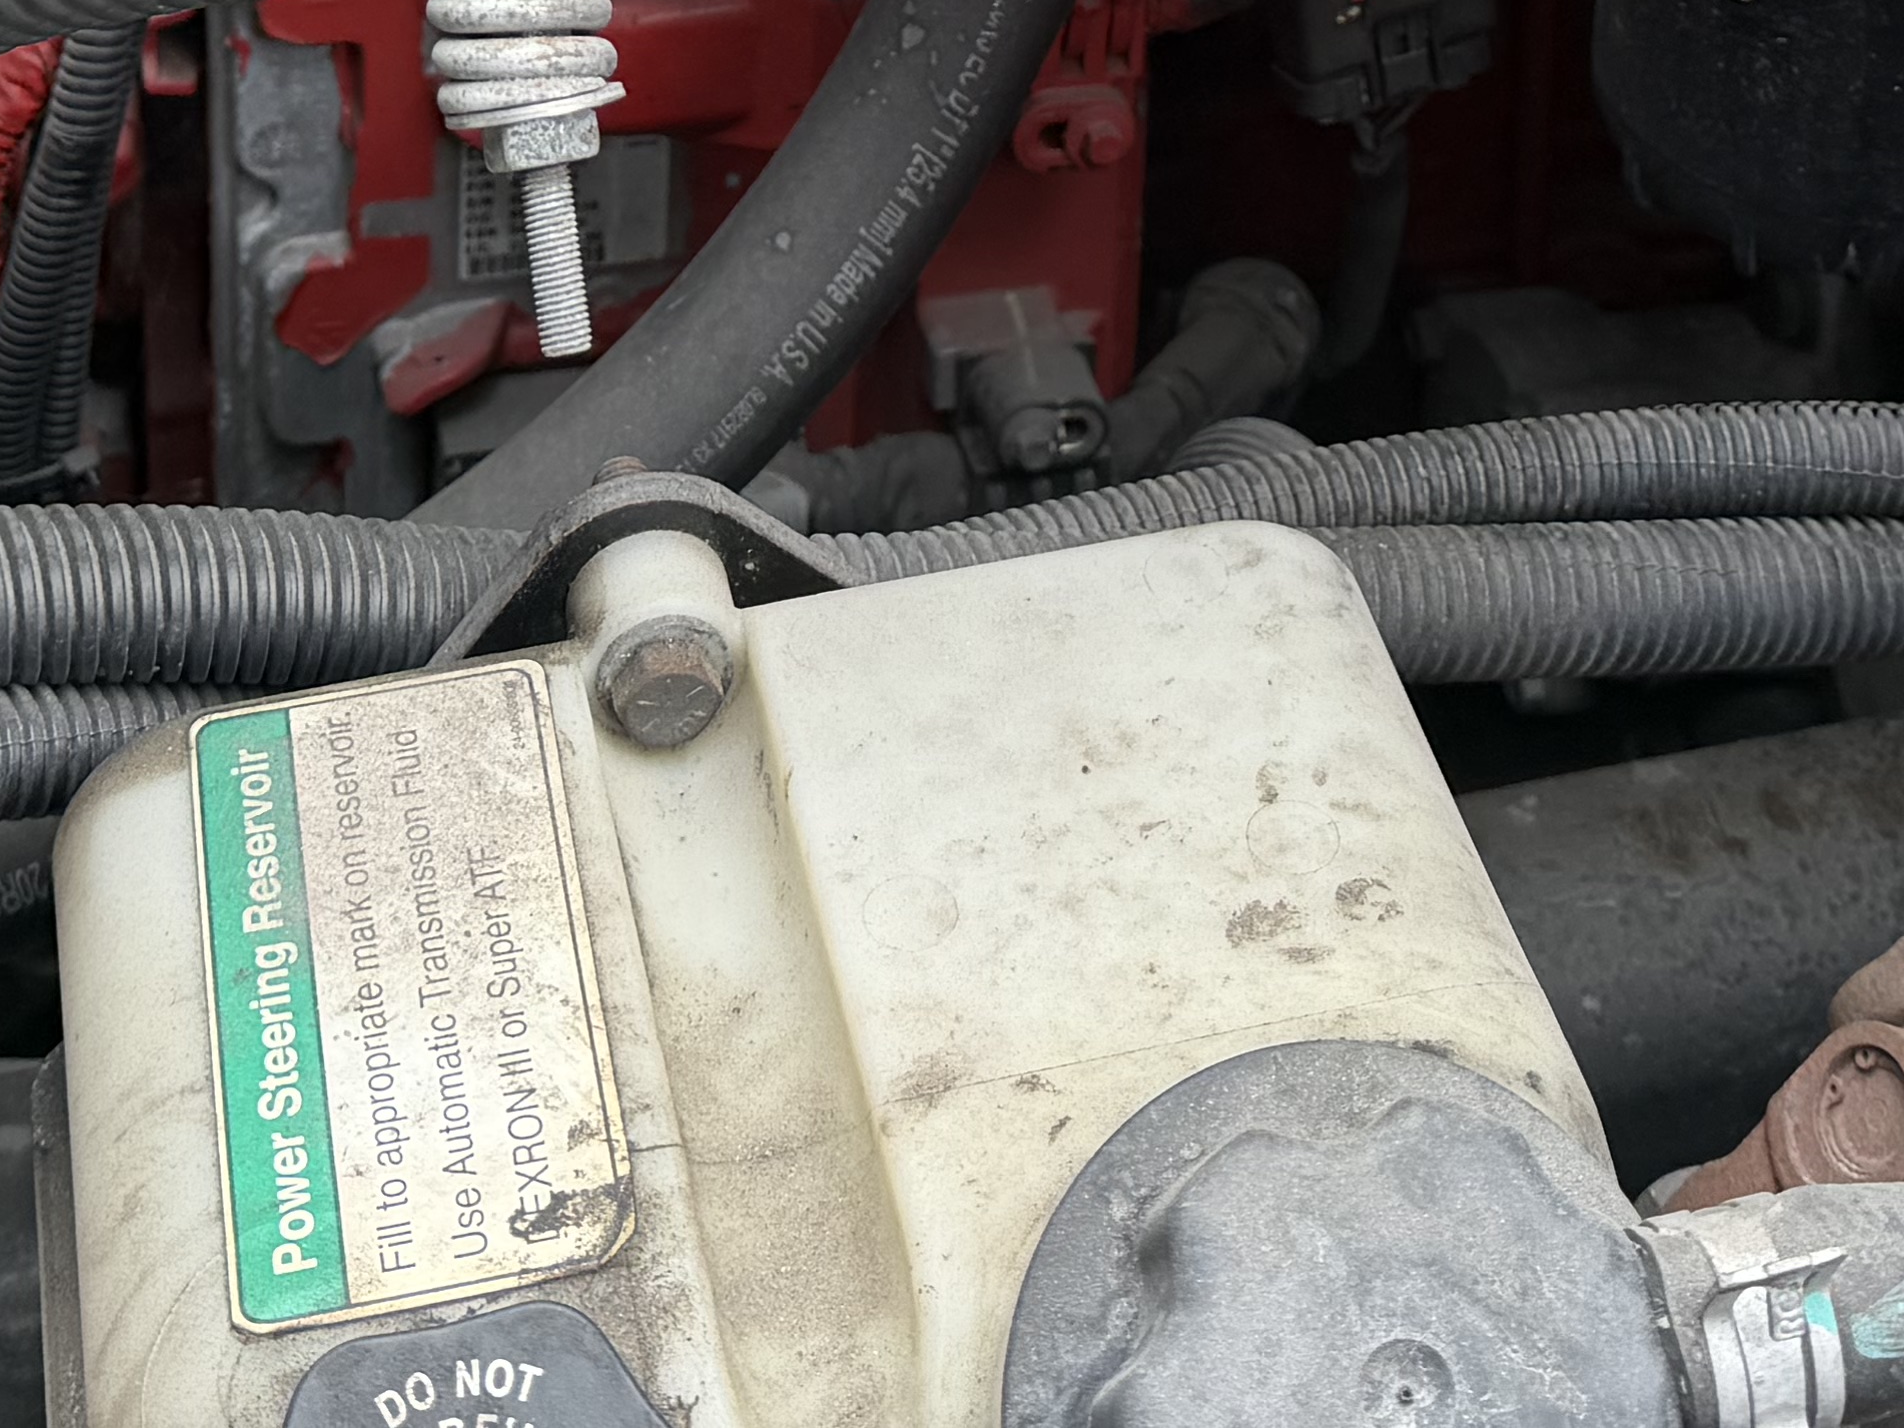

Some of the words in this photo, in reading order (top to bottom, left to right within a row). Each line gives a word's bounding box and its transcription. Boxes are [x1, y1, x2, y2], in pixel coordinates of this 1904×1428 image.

[826, 244, 882, 304] Made
[808, 299, 842, 326] in
[761, 321, 826, 385] U.S.A.
[318, 711, 363, 840] reservoir.
[385, 729, 424, 797] Fluid
[230, 749, 283, 932] Reservoir
[342, 849, 369, 886] on
[339, 894, 378, 972] mark
[403, 805, 451, 1008] Transmission
[480, 910, 522, 998] Super
[249, 942, 301, 1119] Steering
[501, 1009, 527, 1038] or
[353, 982, 408, 1166] appropriate
[427, 1013, 476, 1175] Automatic
[499, 1048, 531, 1076] III
[271, 1133, 317, 1274] Power
[377, 1178, 408, 1208] to
[450, 1187, 487, 1258] Use
[376, 1221, 416, 1272] Fill
[374, 1372, 434, 1428] DO
[456, 1359, 544, 1402] NOT
